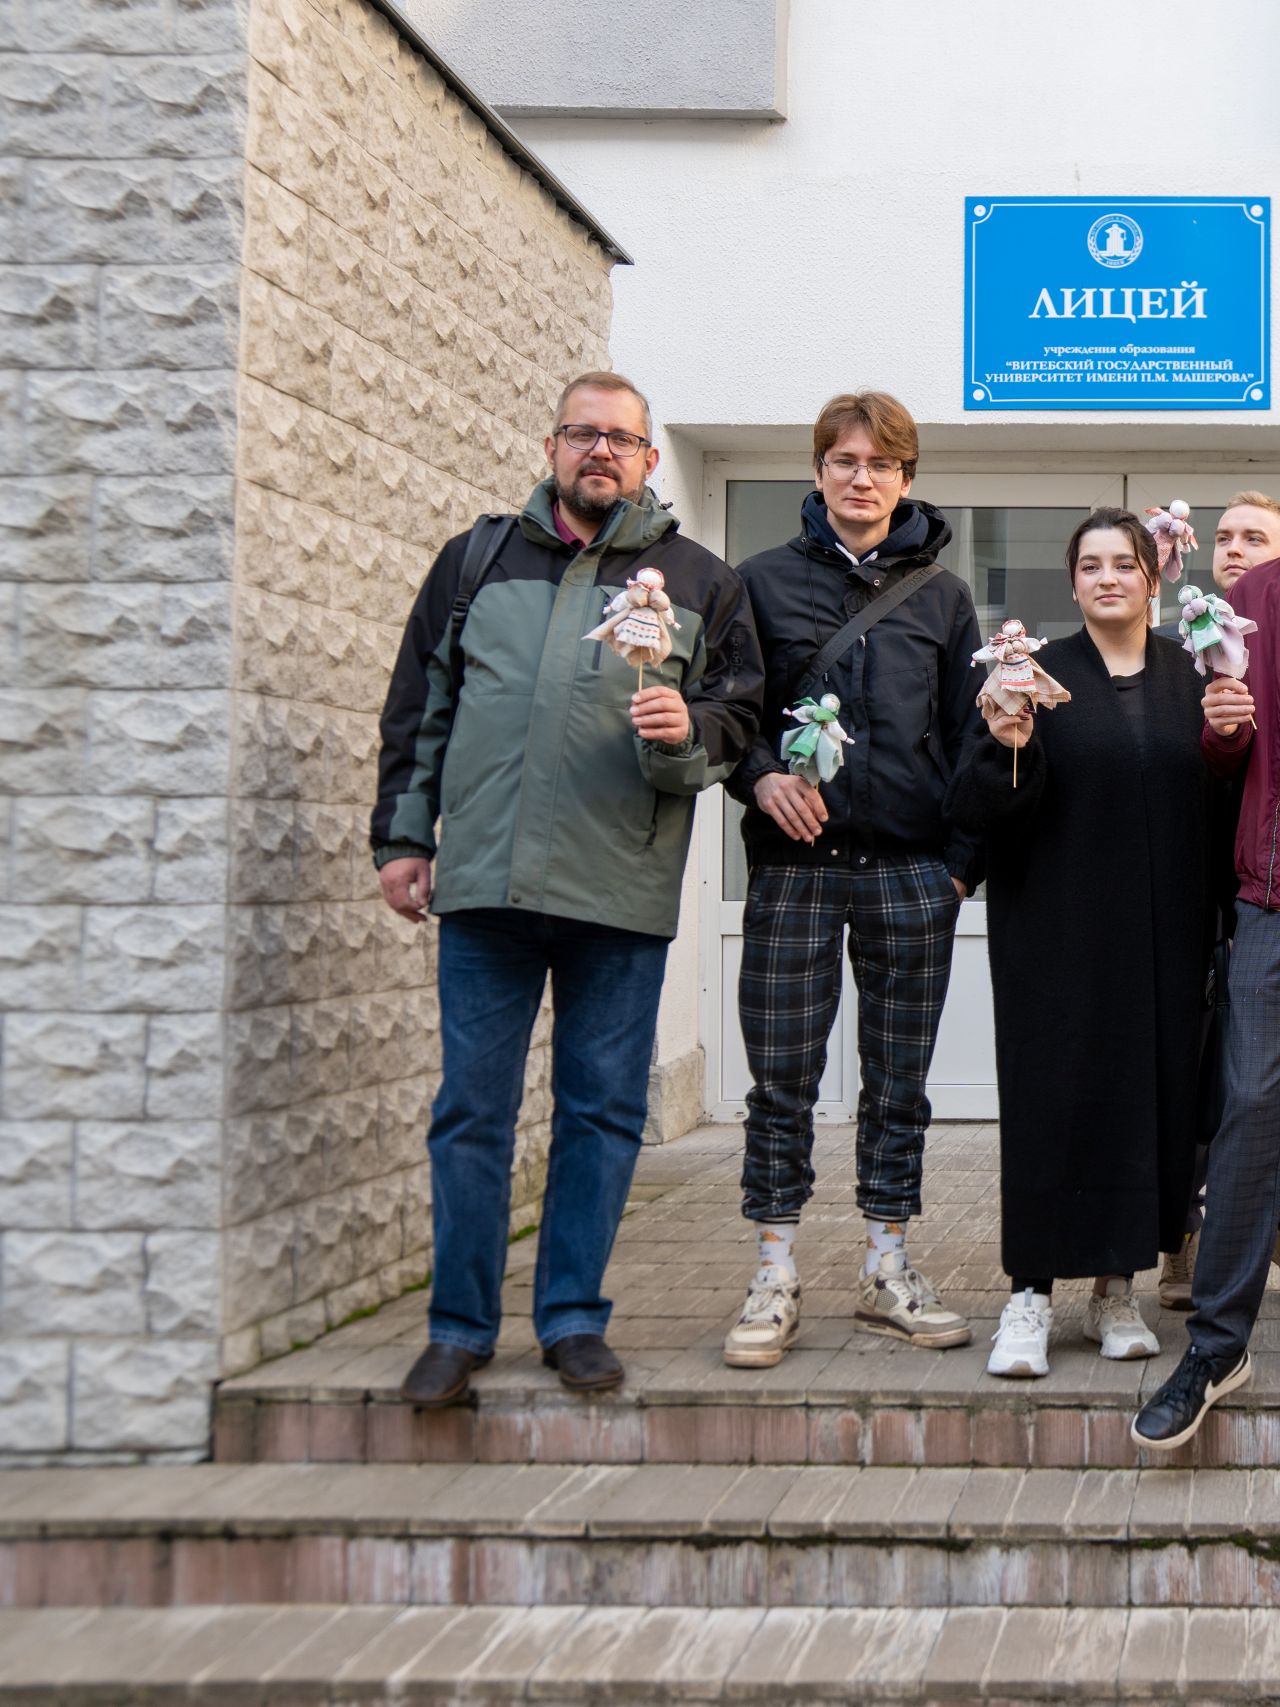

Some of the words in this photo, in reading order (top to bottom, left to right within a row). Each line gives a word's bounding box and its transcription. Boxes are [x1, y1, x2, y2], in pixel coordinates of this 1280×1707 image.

[1028, 280, 1208, 324] ЛИЦЕЙ
[1043, 346, 1117, 357] учреждения
[1119, 343, 1196, 357] образования
[1097, 359, 1234, 371] ГОСУДАРСТВЕННЫЙ
[985, 372, 1084, 383] УНИВЕРСИТЕТ
[1086, 372, 1138, 383] ИМЕНИ
[1141, 372, 1169, 383] П.М.
